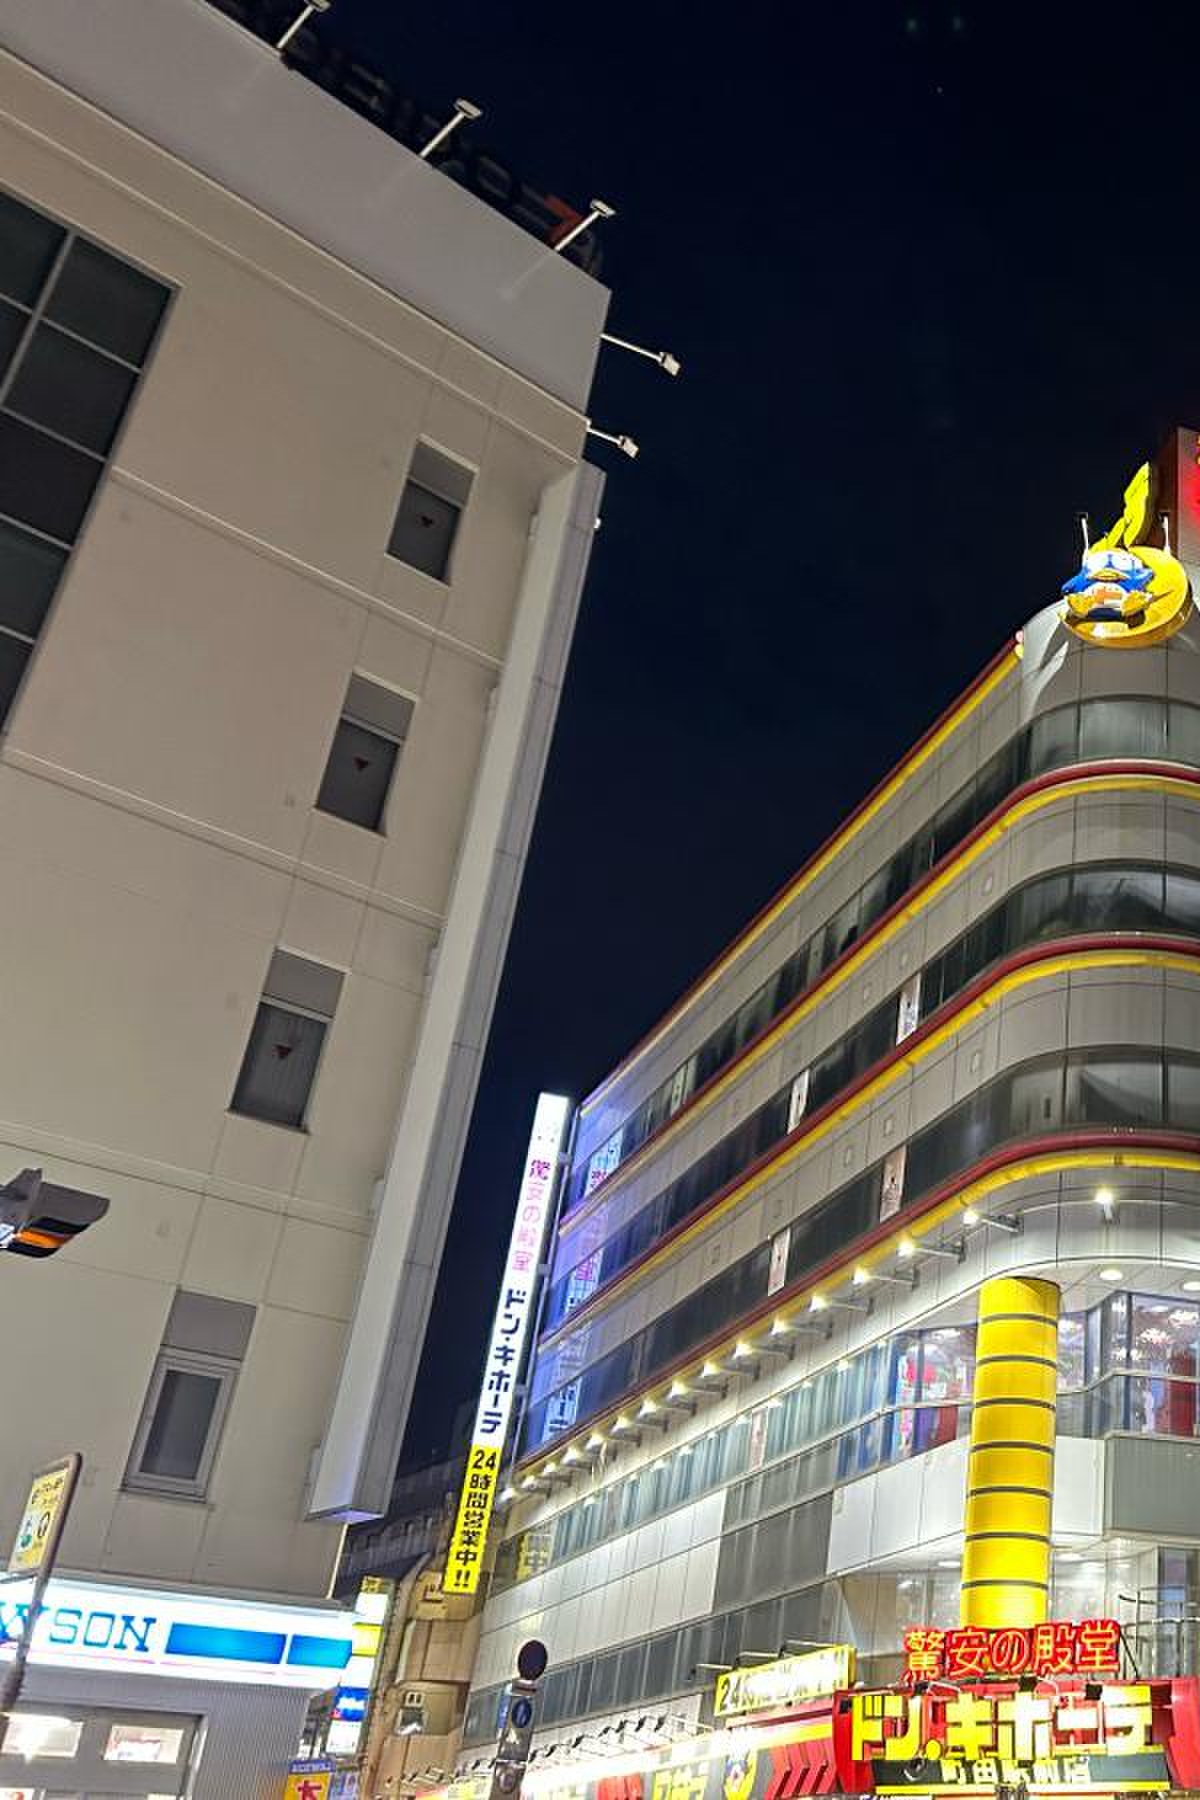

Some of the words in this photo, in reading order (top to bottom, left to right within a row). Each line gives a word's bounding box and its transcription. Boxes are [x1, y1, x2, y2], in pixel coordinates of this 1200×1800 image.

[479, 1288, 528, 1437] ドン・キホーテ
[903, 1620, 1121, 1683] 驚安の殿堂
[851, 1686, 1153, 1760] ドン・キホーテ
